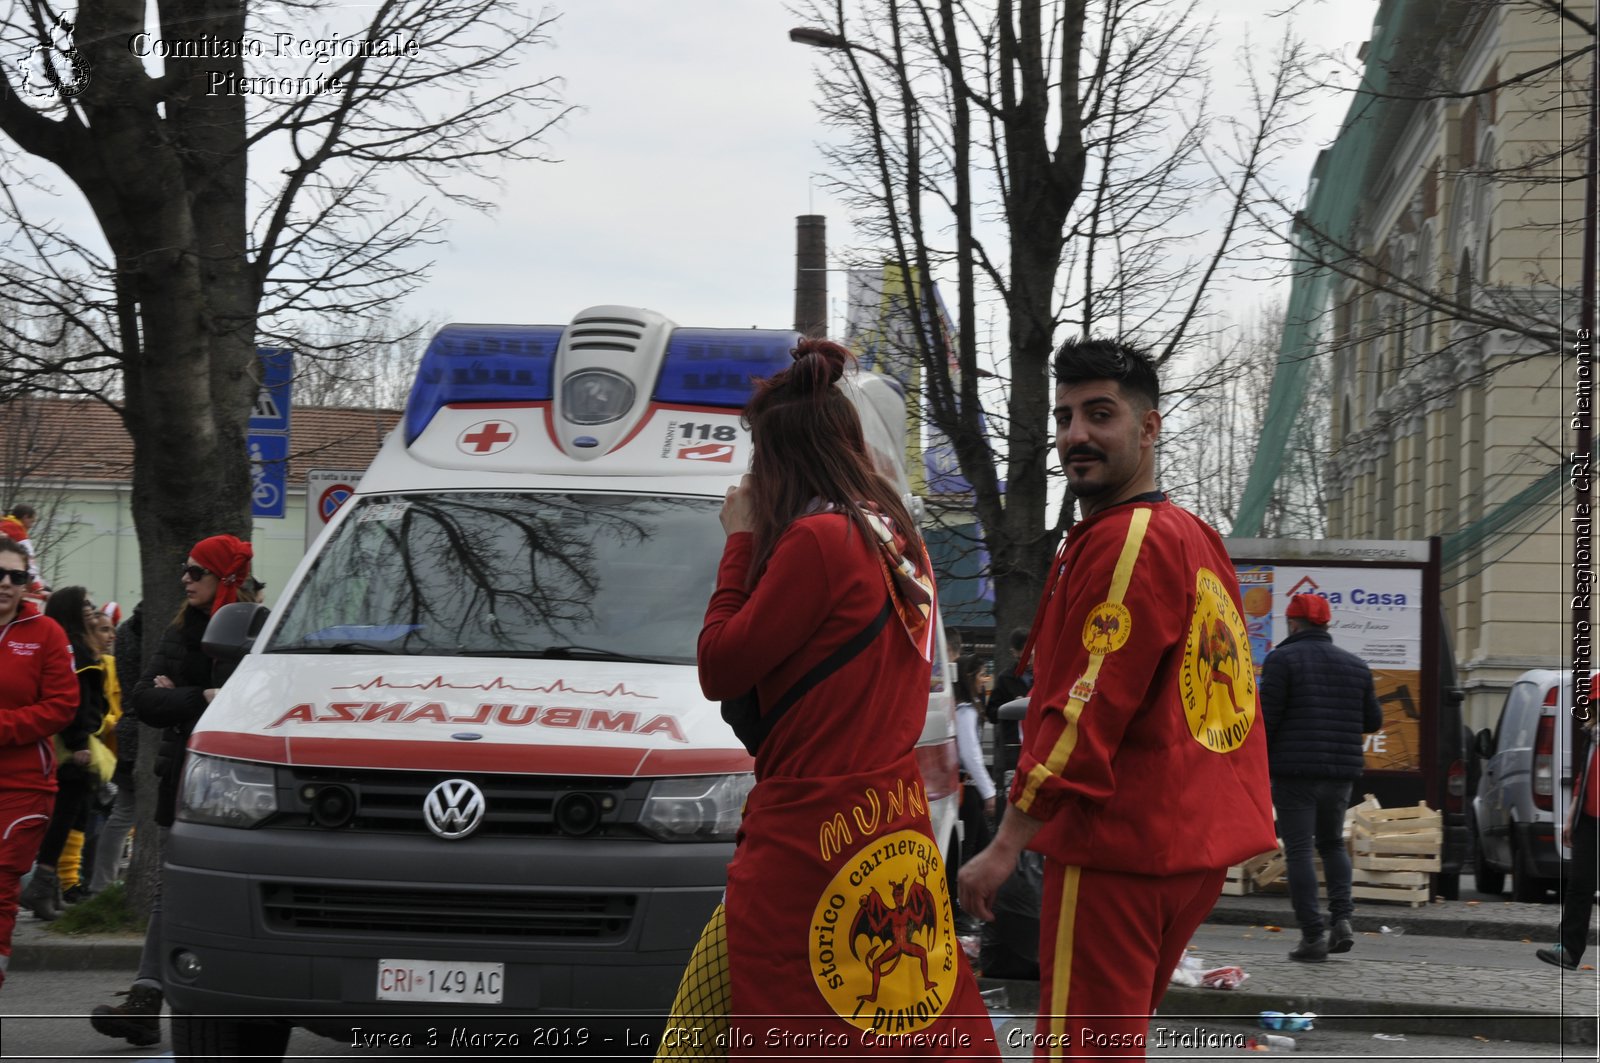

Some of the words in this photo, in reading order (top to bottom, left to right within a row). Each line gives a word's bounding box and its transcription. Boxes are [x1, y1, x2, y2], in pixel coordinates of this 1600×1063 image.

[679, 422, 737, 442] 118
[1336, 548, 1408, 558] COMMERCIALE
[1351, 589, 1407, 606] Casa
[1206, 713, 1250, 750] DIAVOLI
[819, 779, 931, 861] MUNN
[814, 893, 846, 990] storico
[849, 839, 938, 887] carnevale
[381, 968, 414, 992] CRI
[428, 970, 467, 993] 149
[473, 971, 501, 995] AC
[871, 990, 944, 1034] DIAVOLI
